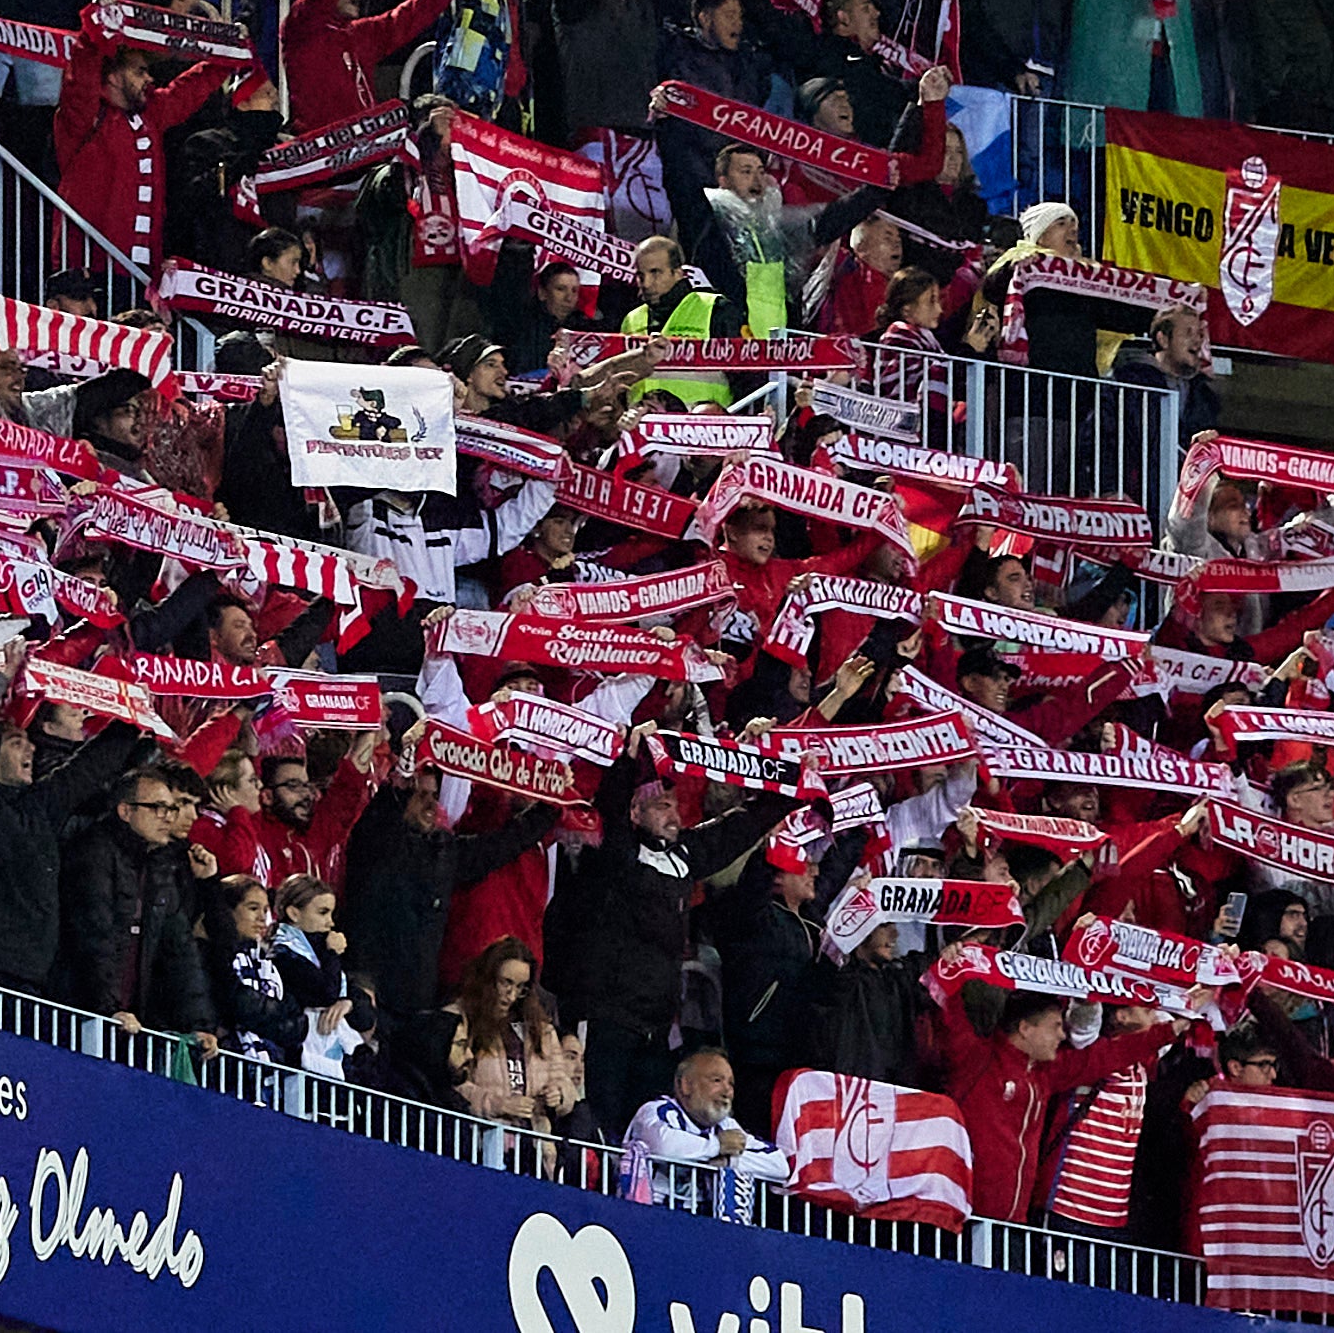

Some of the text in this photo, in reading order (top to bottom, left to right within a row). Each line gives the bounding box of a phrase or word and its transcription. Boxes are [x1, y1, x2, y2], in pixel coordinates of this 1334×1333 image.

[712, 104, 869, 175] GRANADA C.F.
[1119, 186, 1214, 244] VENGO
[1276, 224, 1296, 259] A
[195, 275, 406, 331] GRANADA C.F.
[287, 318, 327, 338] POR
[329, 325, 381, 346] VERTE
[699, 338, 735, 362] Club
[739, 338, 762, 361] de
[858, 439, 1009, 488] HORIZONTAL
[622, 487, 675, 524] 1931
[747, 461, 846, 514] GRANADA
[518, 622, 553, 639] Peña
[942, 604, 1131, 658] LA HORIZONTAL
[544, 640, 662, 666] Rojiblanco
[306, 693, 355, 712] GRANADA
[1250, 714, 1277, 733] LA
[429, 731, 530, 786] Granada Club de
[679, 738, 763, 781] GRANADA
[828, 720, 969, 762] HORIZONTAL
[1214, 803, 1256, 849] LA
[879, 883, 973, 914] GRANADA
[1112, 925, 1183, 969] GRANADA
[995, 952, 1133, 1001] GRANADA
[29, 1146, 204, 1289] Olmedo
